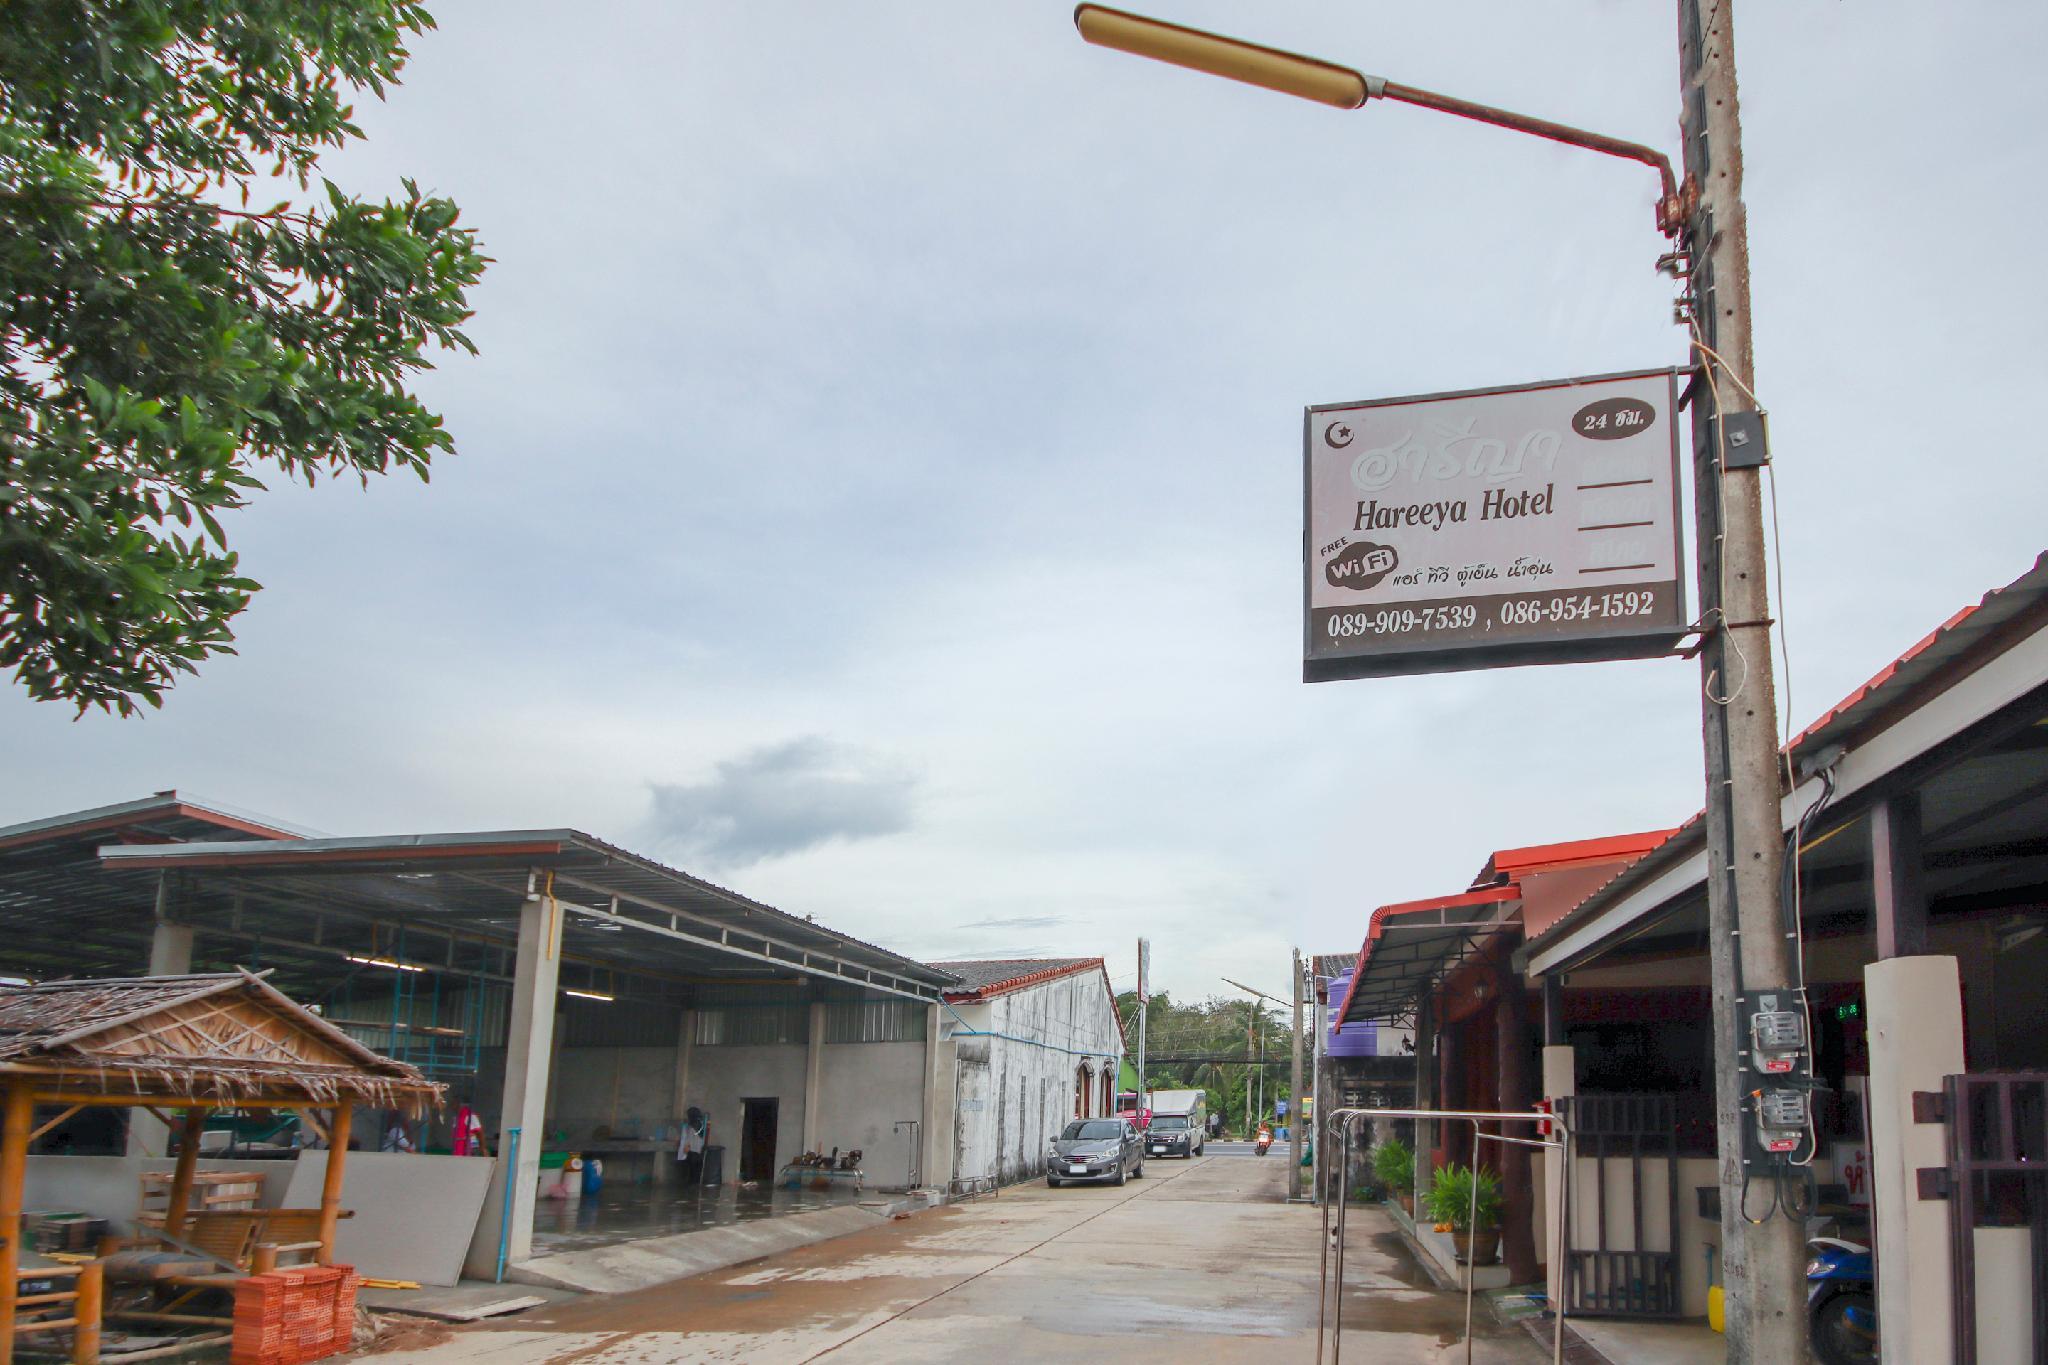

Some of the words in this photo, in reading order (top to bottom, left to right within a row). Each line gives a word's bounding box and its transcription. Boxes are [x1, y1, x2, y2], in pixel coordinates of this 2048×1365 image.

[1584, 413, 1607, 430] 24
[1353, 499, 1466, 531] Hareeya
[1481, 483, 1554, 520] Hotel
[1320, 536, 1348, 557] FREE
[1392, 568, 1422, 586] แอร์
[1428, 567, 1449, 584] ทีวี
[1457, 563, 1498, 587] ตู้เย็น
[1507, 556, 1553, 580] น้ำอุ่น
[1328, 605, 1477, 637] 089-909-7539
[1500, 591, 1654, 625] 086-954-1592
